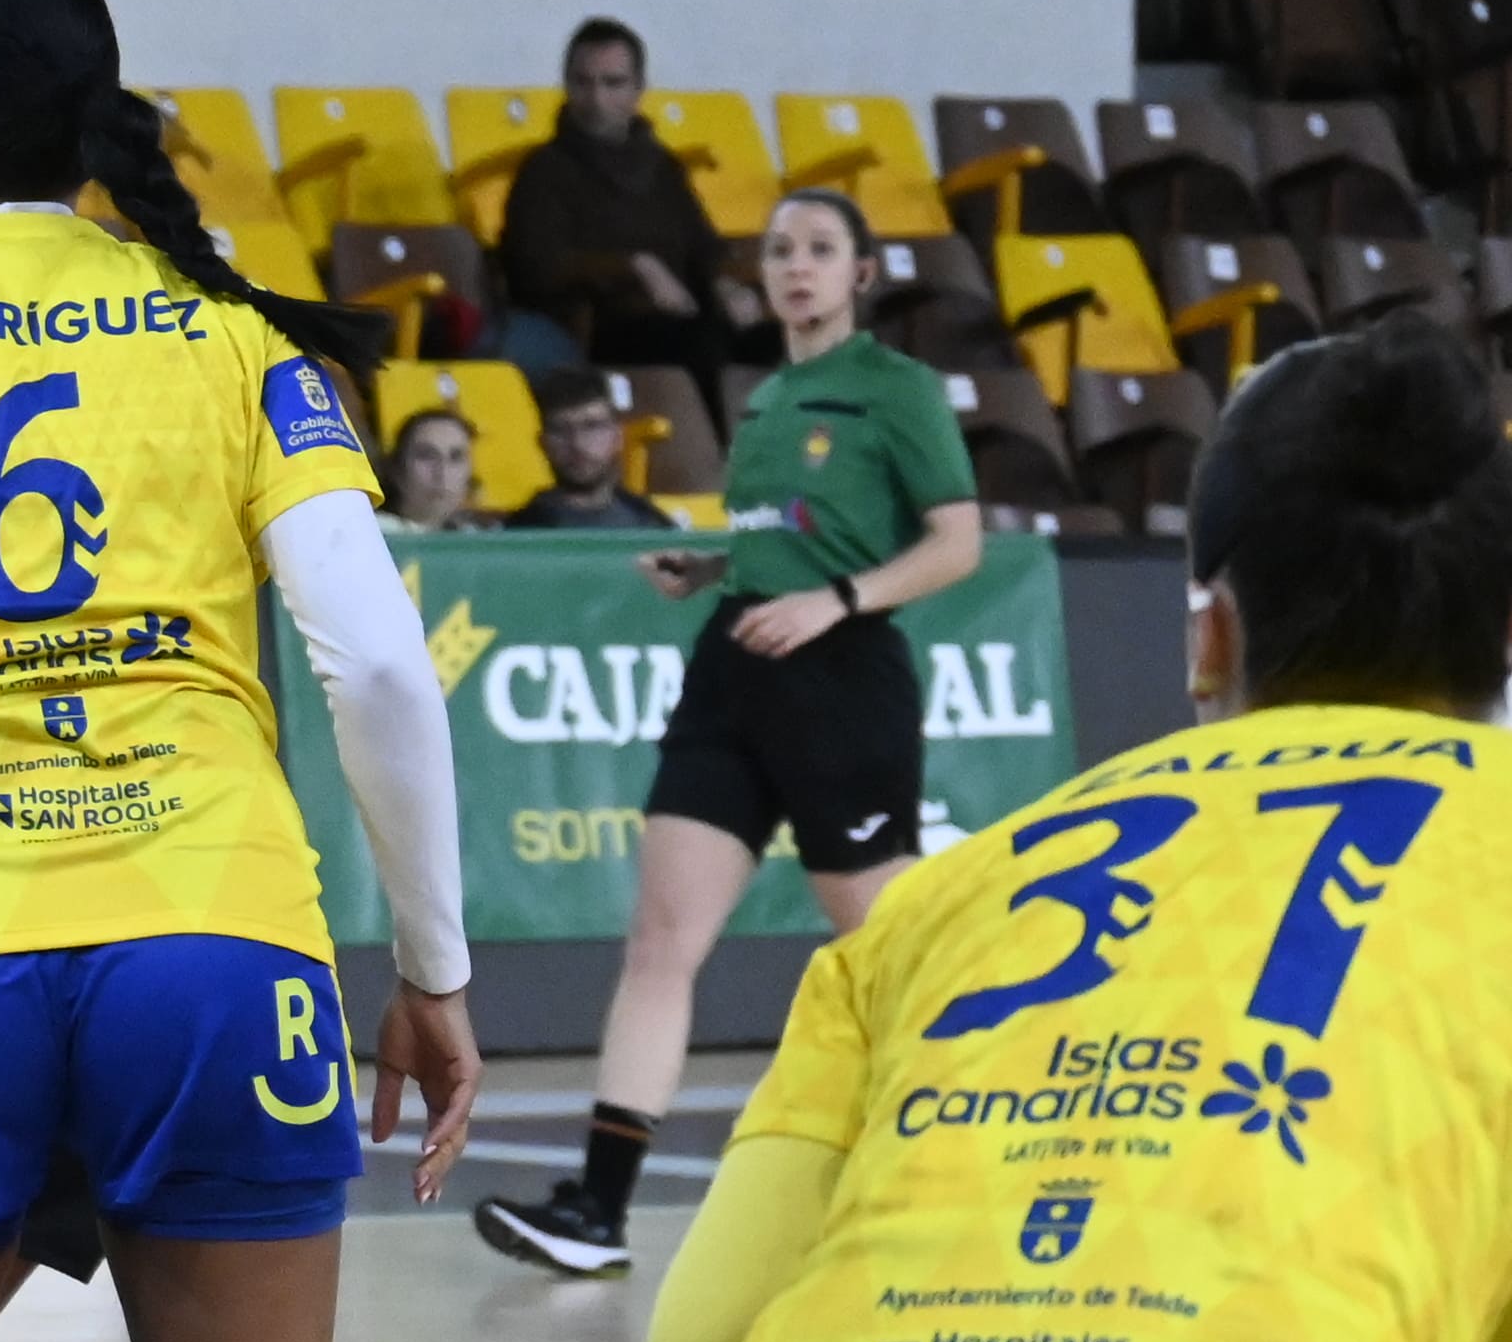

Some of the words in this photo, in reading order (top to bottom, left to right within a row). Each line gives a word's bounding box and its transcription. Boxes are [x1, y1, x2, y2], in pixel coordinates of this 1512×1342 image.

[19, 780, 151, 810] Hospitales
[20, 808, 75, 831] SAN
[83, 796, 185, 829] ROQUE
[275, 977, 319, 1061] R
[1046, 1031, 1202, 1077] Islas
[895, 1082, 1187, 1138] Canarias
[877, 1284, 1076, 1315] Ayuntamiento
[1083, 1286, 1117, 1308] de
[1125, 1286, 1200, 1318] Telde
